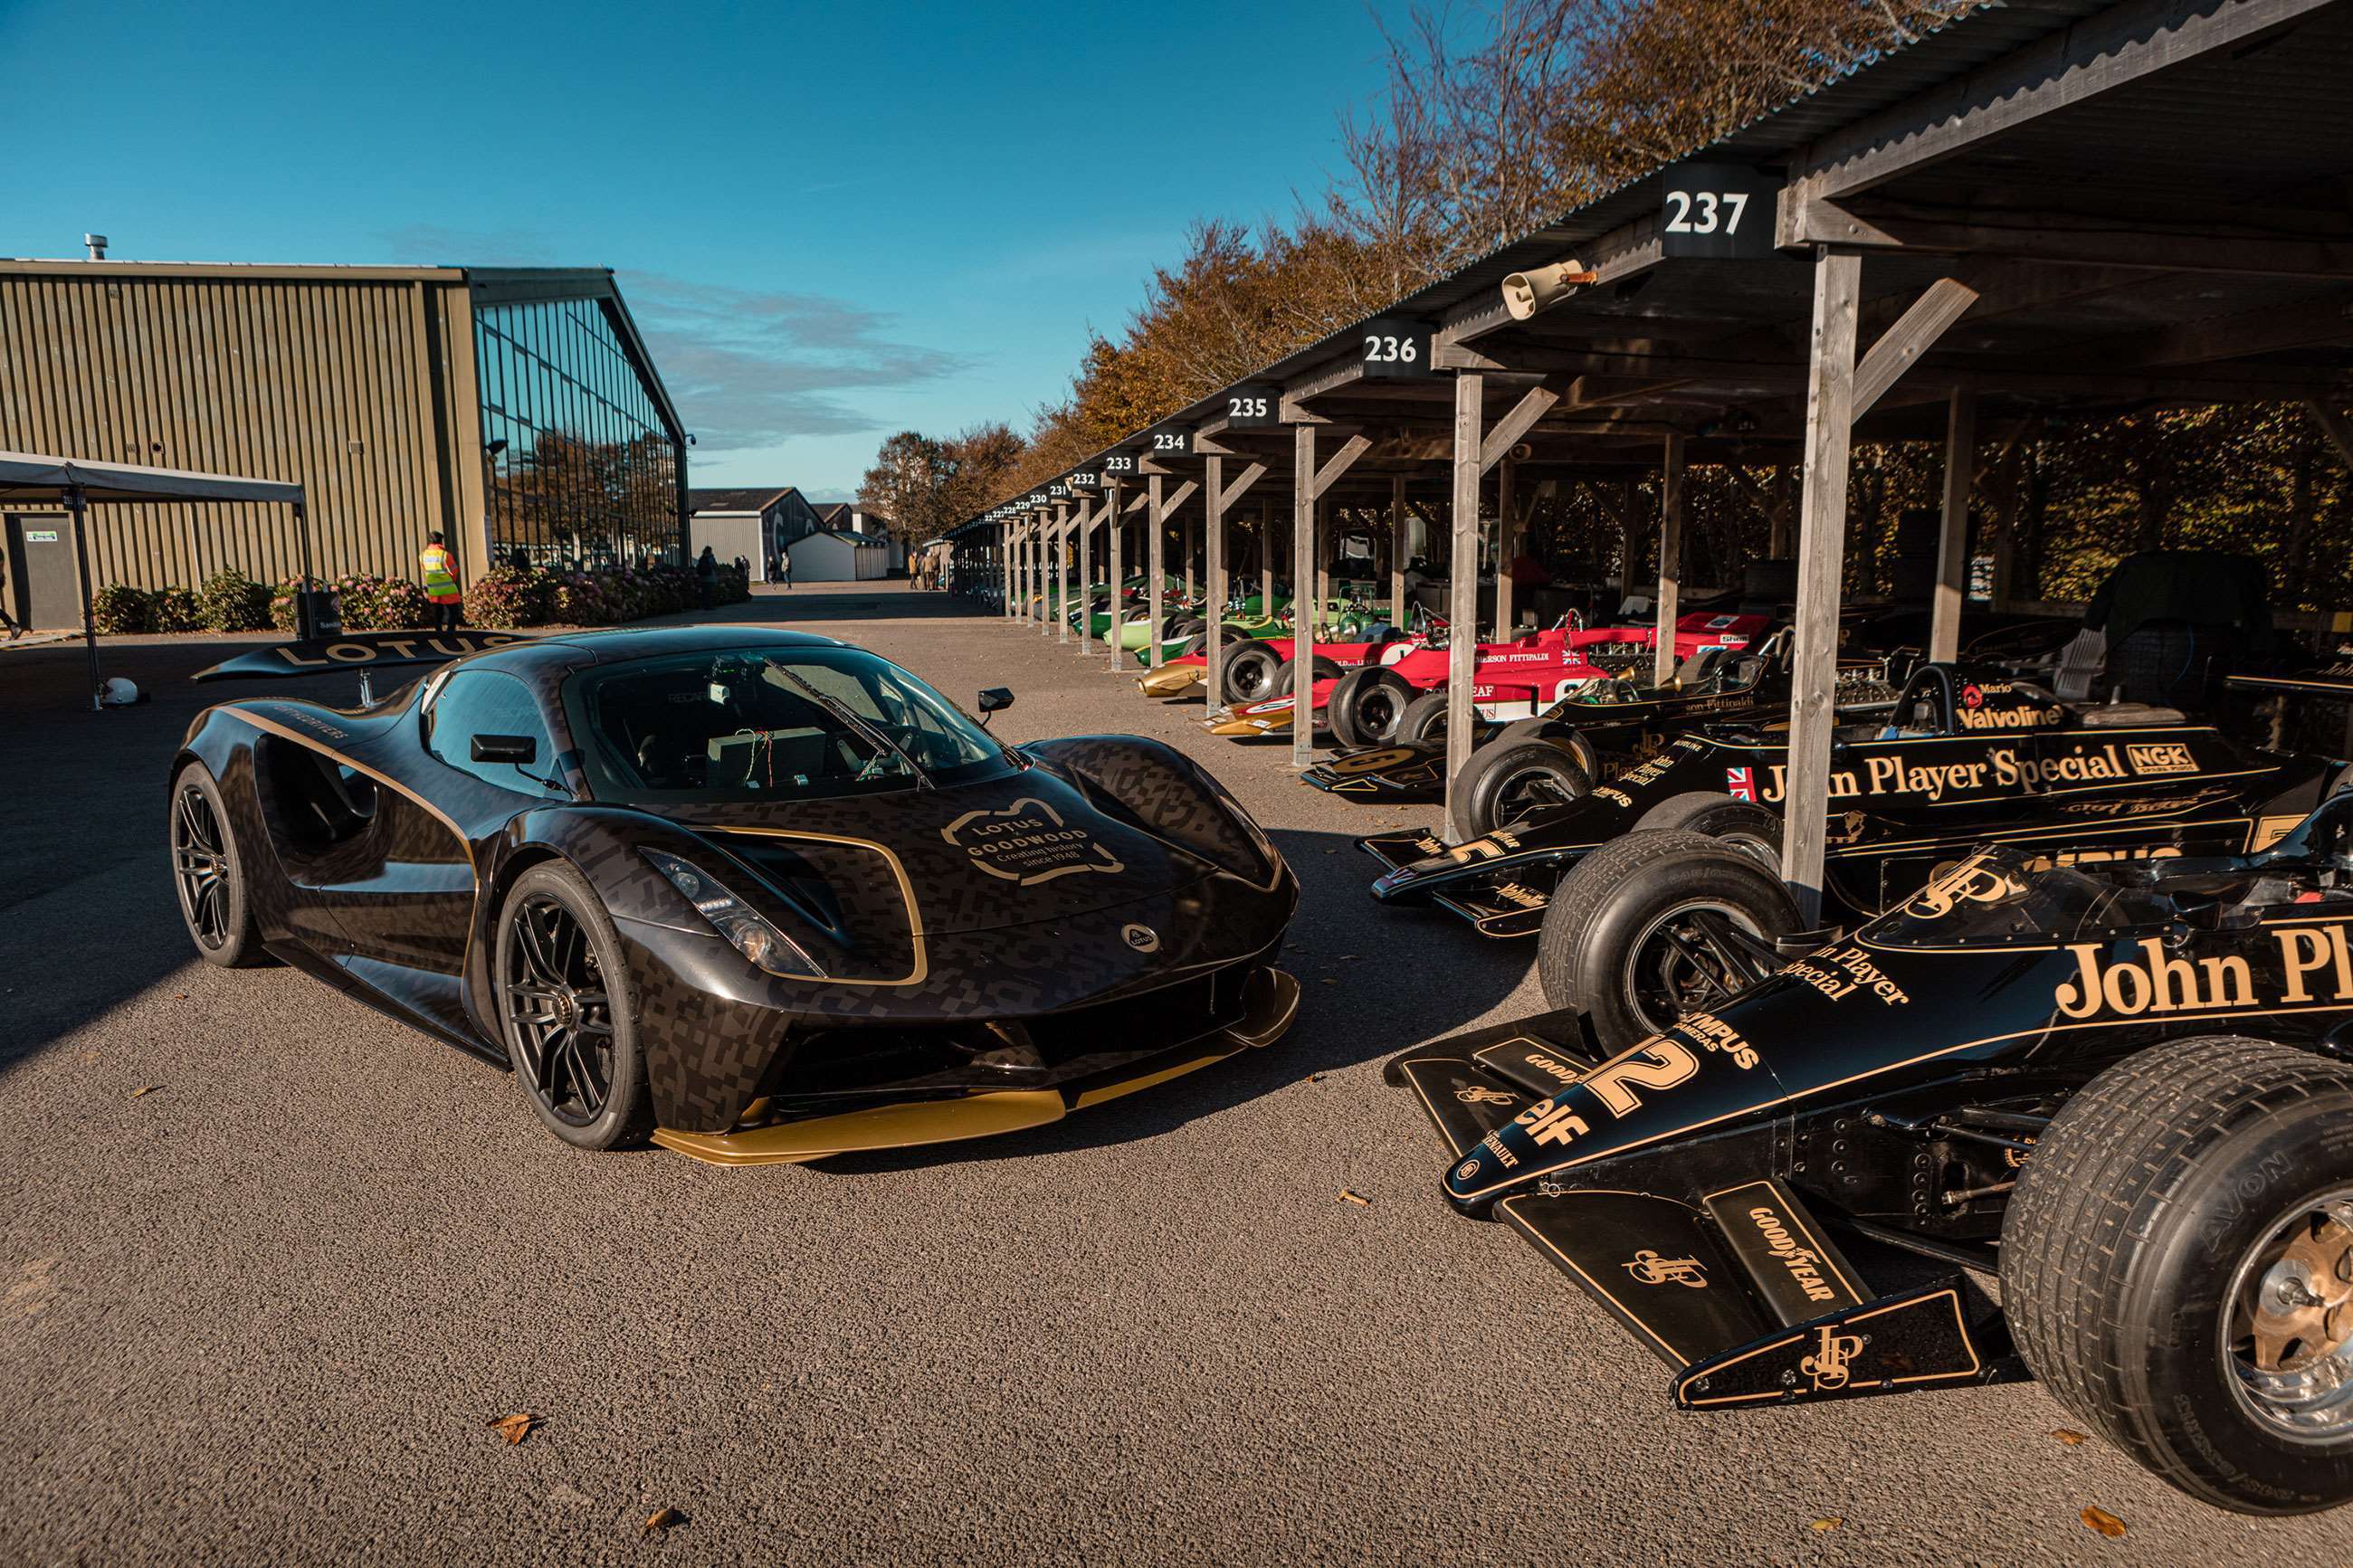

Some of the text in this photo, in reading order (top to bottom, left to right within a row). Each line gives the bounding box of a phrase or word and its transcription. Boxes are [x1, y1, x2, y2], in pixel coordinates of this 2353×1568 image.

[1665, 190, 1749, 236] 237
[1365, 336, 1417, 363] 236
[1229, 398, 1267, 417] 235
[1154, 434, 1185, 450] 234
[1106, 457, 1131, 470] 233
[1072, 473, 1096, 485] 232
[1030, 494, 1047, 503] 230
[1050, 485, 1067, 496] 231
[1015, 501, 1031, 509] 229
[1476, 653, 1549, 663] MERSON FITTIPALDI
[1472, 686, 1494, 698] EAF
[1978, 683, 2013, 694] Mario
[1956, 705, 2062, 729] Valvoline
[2130, 746, 2189, 767] NGK
[1762, 744, 2129, 803] Jn Player Special
[972, 818, 1043, 836] LOTUS
[967, 830, 1089, 857] GOODWOOD
[996, 842, 1085, 862] Creating history
[1022, 851, 1081, 867] since 1948
[1830, 947, 1910, 1006] Player
[2054, 937, 2259, 1019] John
[1584, 1040, 1700, 1119] 2
[1514, 1098, 1591, 1146] elf
[2200, 1150, 2293, 1254] AVON
[1748, 1207, 1835, 1303] GOODYEAR
